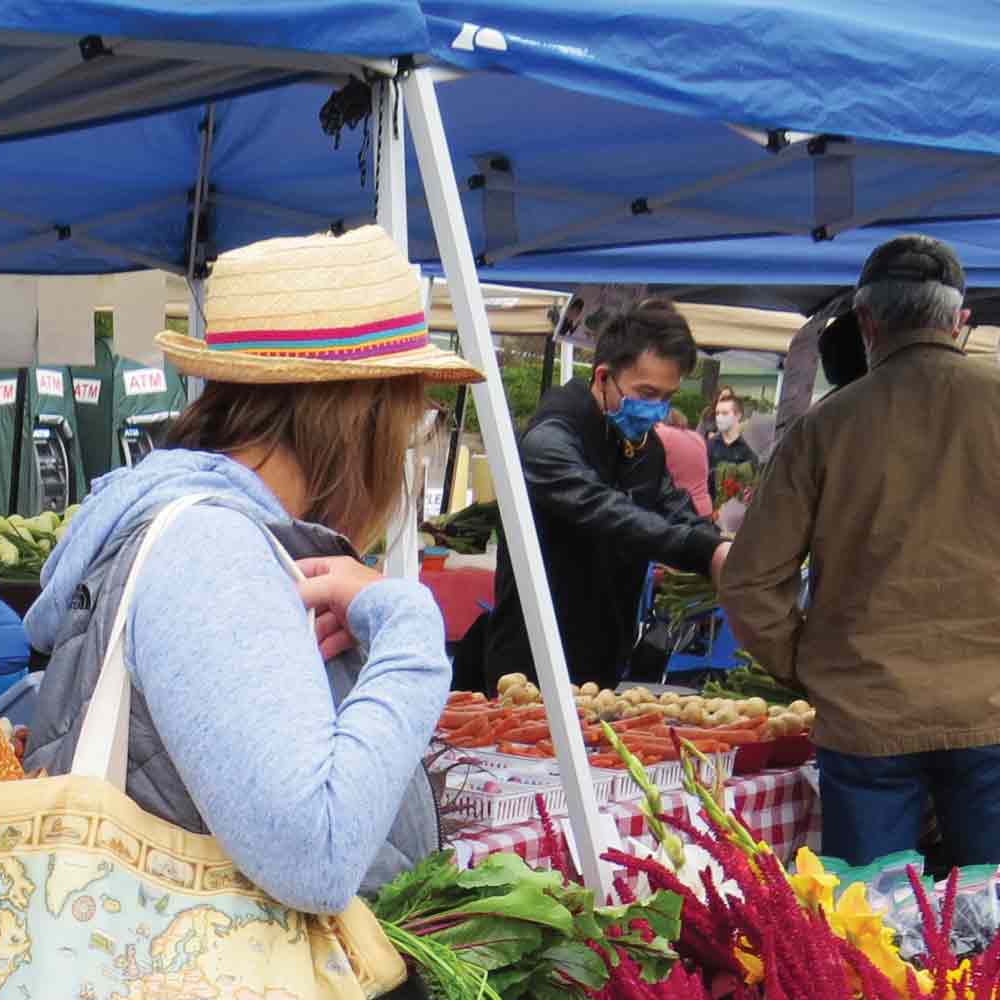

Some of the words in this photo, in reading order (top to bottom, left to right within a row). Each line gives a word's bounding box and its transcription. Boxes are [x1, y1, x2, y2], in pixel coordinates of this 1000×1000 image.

[40, 376, 62, 392] ATM
[129, 373, 163, 390] ATM
[74, 384, 99, 399] ATM
